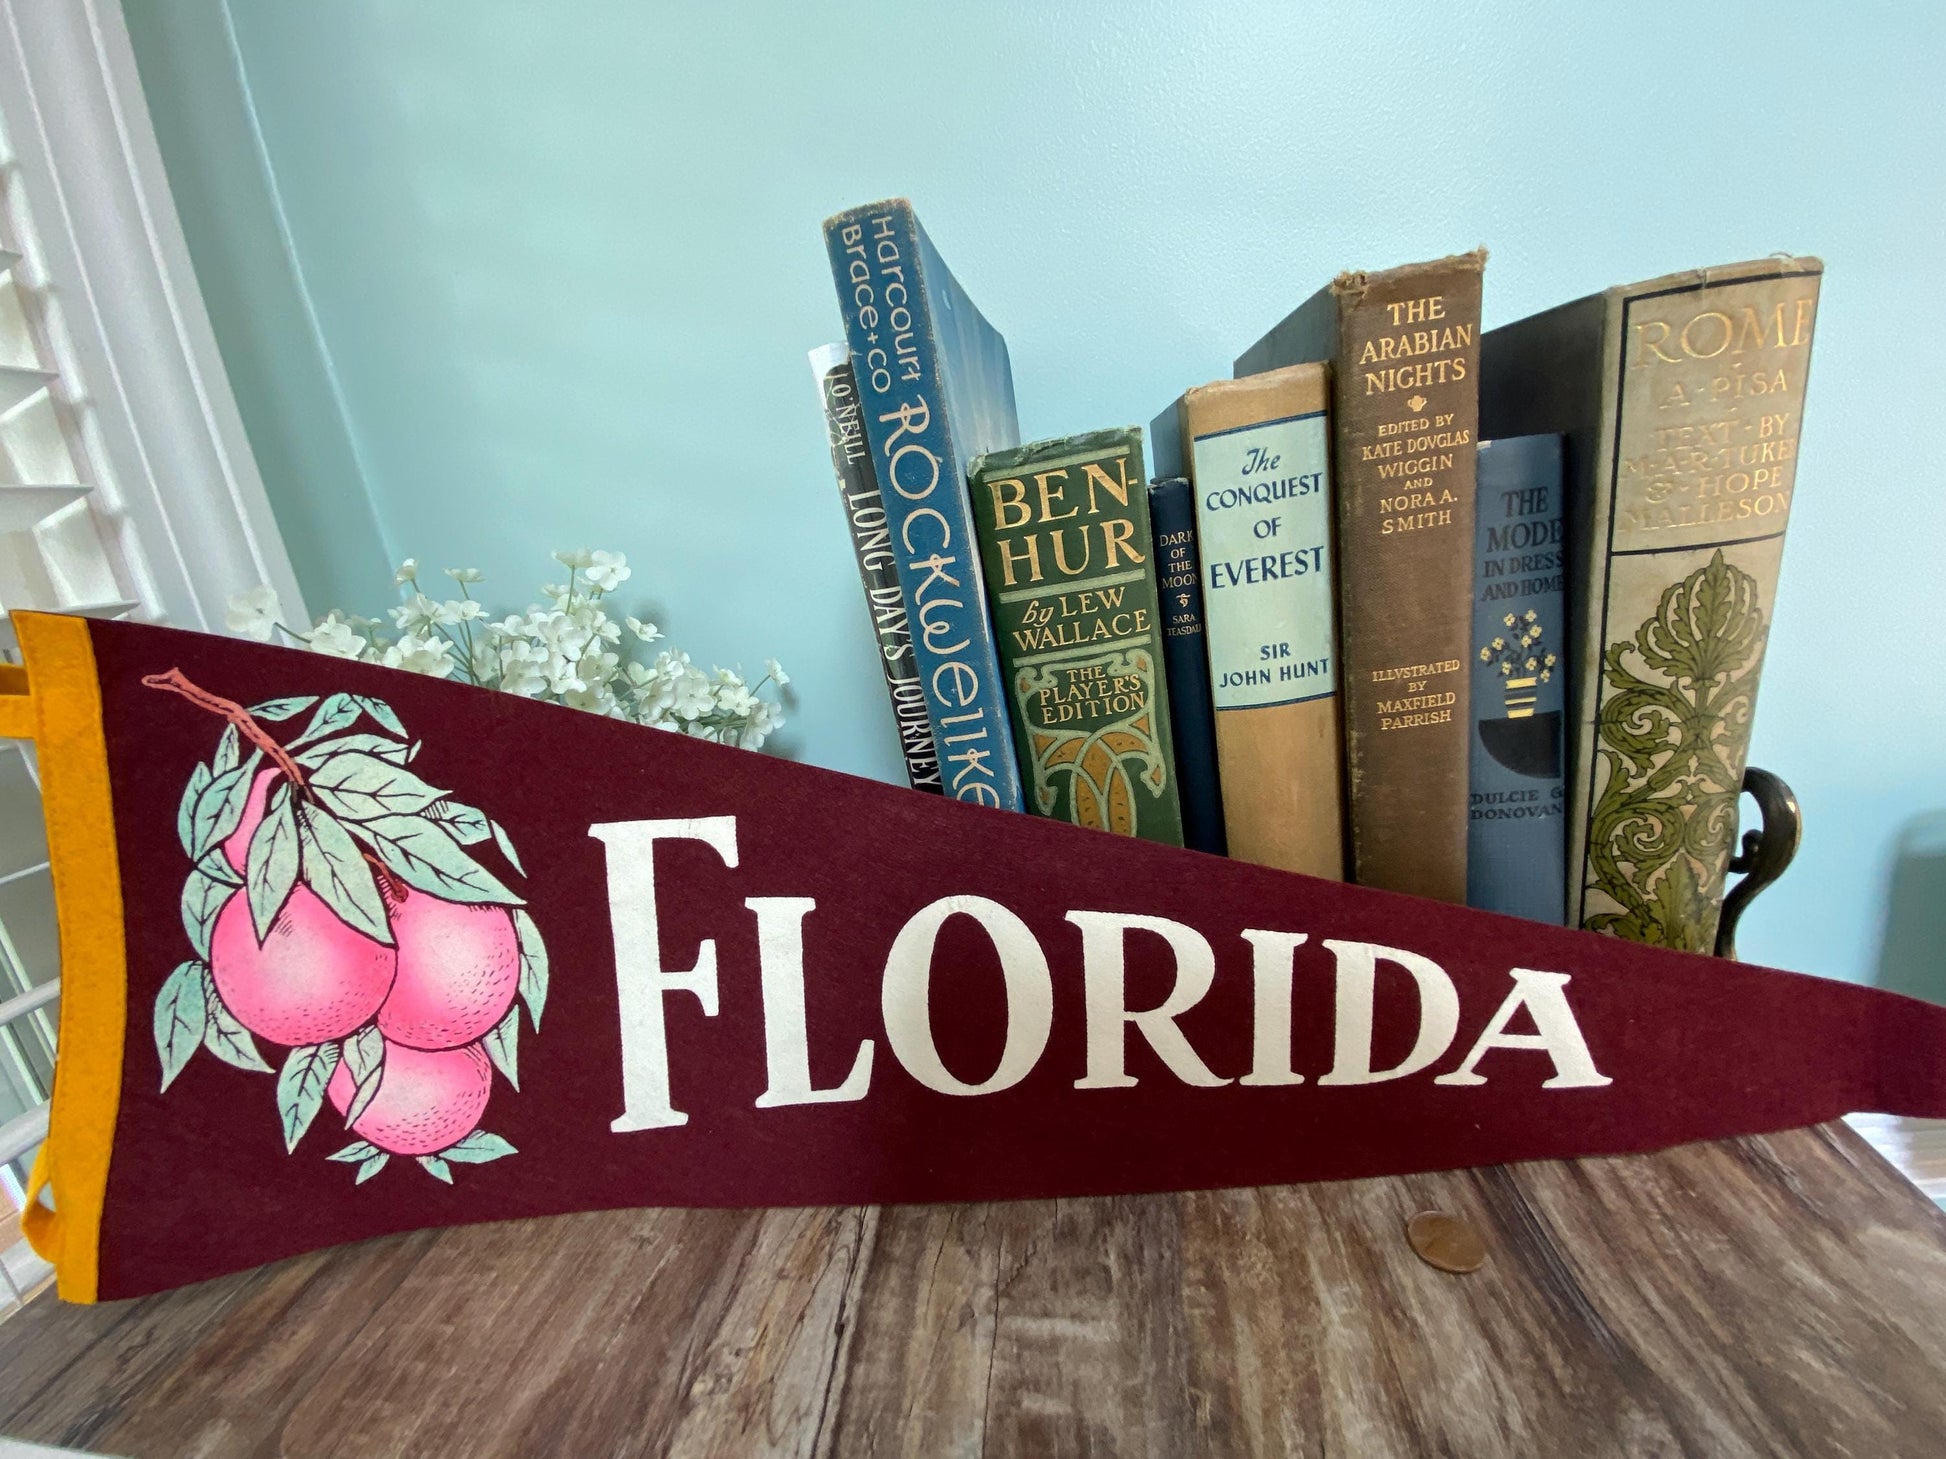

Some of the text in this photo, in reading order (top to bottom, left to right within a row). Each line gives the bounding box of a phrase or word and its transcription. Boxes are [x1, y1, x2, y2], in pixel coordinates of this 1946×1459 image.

[872, 216, 921, 381] Harcourt
[1387, 296, 1446, 326] THE
[1359, 323, 1473, 365] ARABIAN
[1631, 299, 1813, 370] ROME
[1365, 358, 1467, 395] NIGHTS
[831, 383, 866, 465] O'NEILL
[1378, 413, 1454, 437] EDITED BY
[1759, 413, 1790, 439] BY
[1362, 430, 1470, 460] KATE DOVGLAS
[1241, 447, 1281, 476] The
[1378, 453, 1454, 479] WIGGIN
[987, 457, 1138, 530] BEN-
[1206, 472, 1324, 511] CONQUEST
[1403, 477, 1434, 490] AND
[1696, 466, 1783, 498] HOPE
[1380, 489, 1458, 513] NORA A.
[1501, 486, 1549, 518] THE
[1253, 517, 1283, 539] OF
[1382, 509, 1452, 534] SMITH
[997, 518, 1146, 586] HUR
[1160, 530, 1194, 546] DARK
[1168, 560, 1192, 573] THE
[1170, 547, 1187, 559] OF
[1210, 546, 1325, 589] EVEREST
[1483, 559, 1505, 578] IN
[1480, 581, 1519, 602] AND
[1021, 586, 1126, 628] by LEW
[1172, 613, 1195, 624] SARA
[847, 489, 895, 571] LONG
[887, 673, 942, 786] JOURNEY
[1013, 609, 1151, 651] WALLACE
[1260, 642, 1291, 661] SIR
[1066, 666, 1106, 683] THE
[1220, 658, 1329, 688] JOHN HUNT
[1408, 680, 1427, 692] BY
[1039, 674, 1142, 706] PLAYER'S
[1376, 692, 1456, 714] MAXFIELD
[1041, 691, 1145, 725] EDITION
[1381, 709, 1452, 730] PARRISH
[1470, 790, 1539, 805] DULCIE
[1470, 803, 1563, 819] DONOVAN
[587, 814, 1613, 1134] FLORIDA
